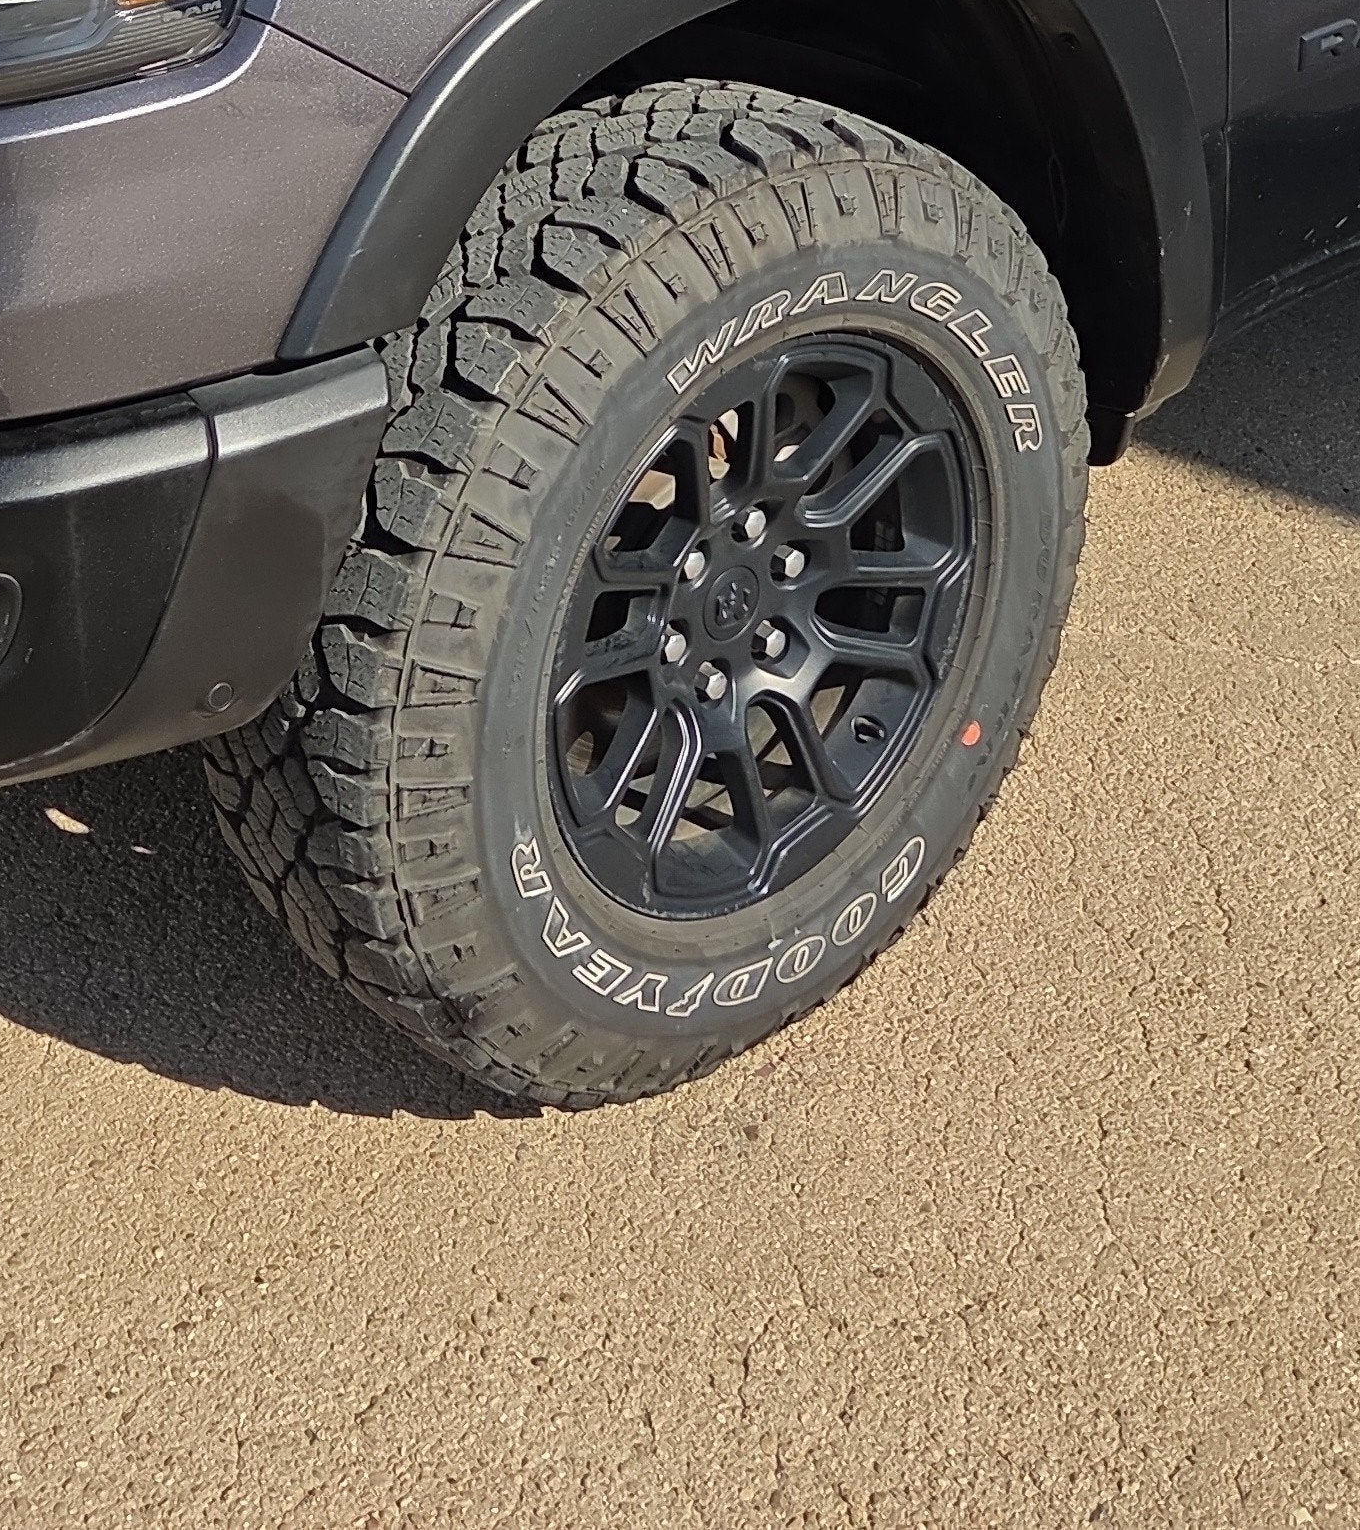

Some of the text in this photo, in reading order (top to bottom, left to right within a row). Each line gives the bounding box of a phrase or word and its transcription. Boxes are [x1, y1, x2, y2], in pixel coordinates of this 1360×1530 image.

[161, 0, 222, 22] RAM
[665, 268, 1043, 454] WRANGLER
[511, 835, 926, 1018] GOODYEAR
